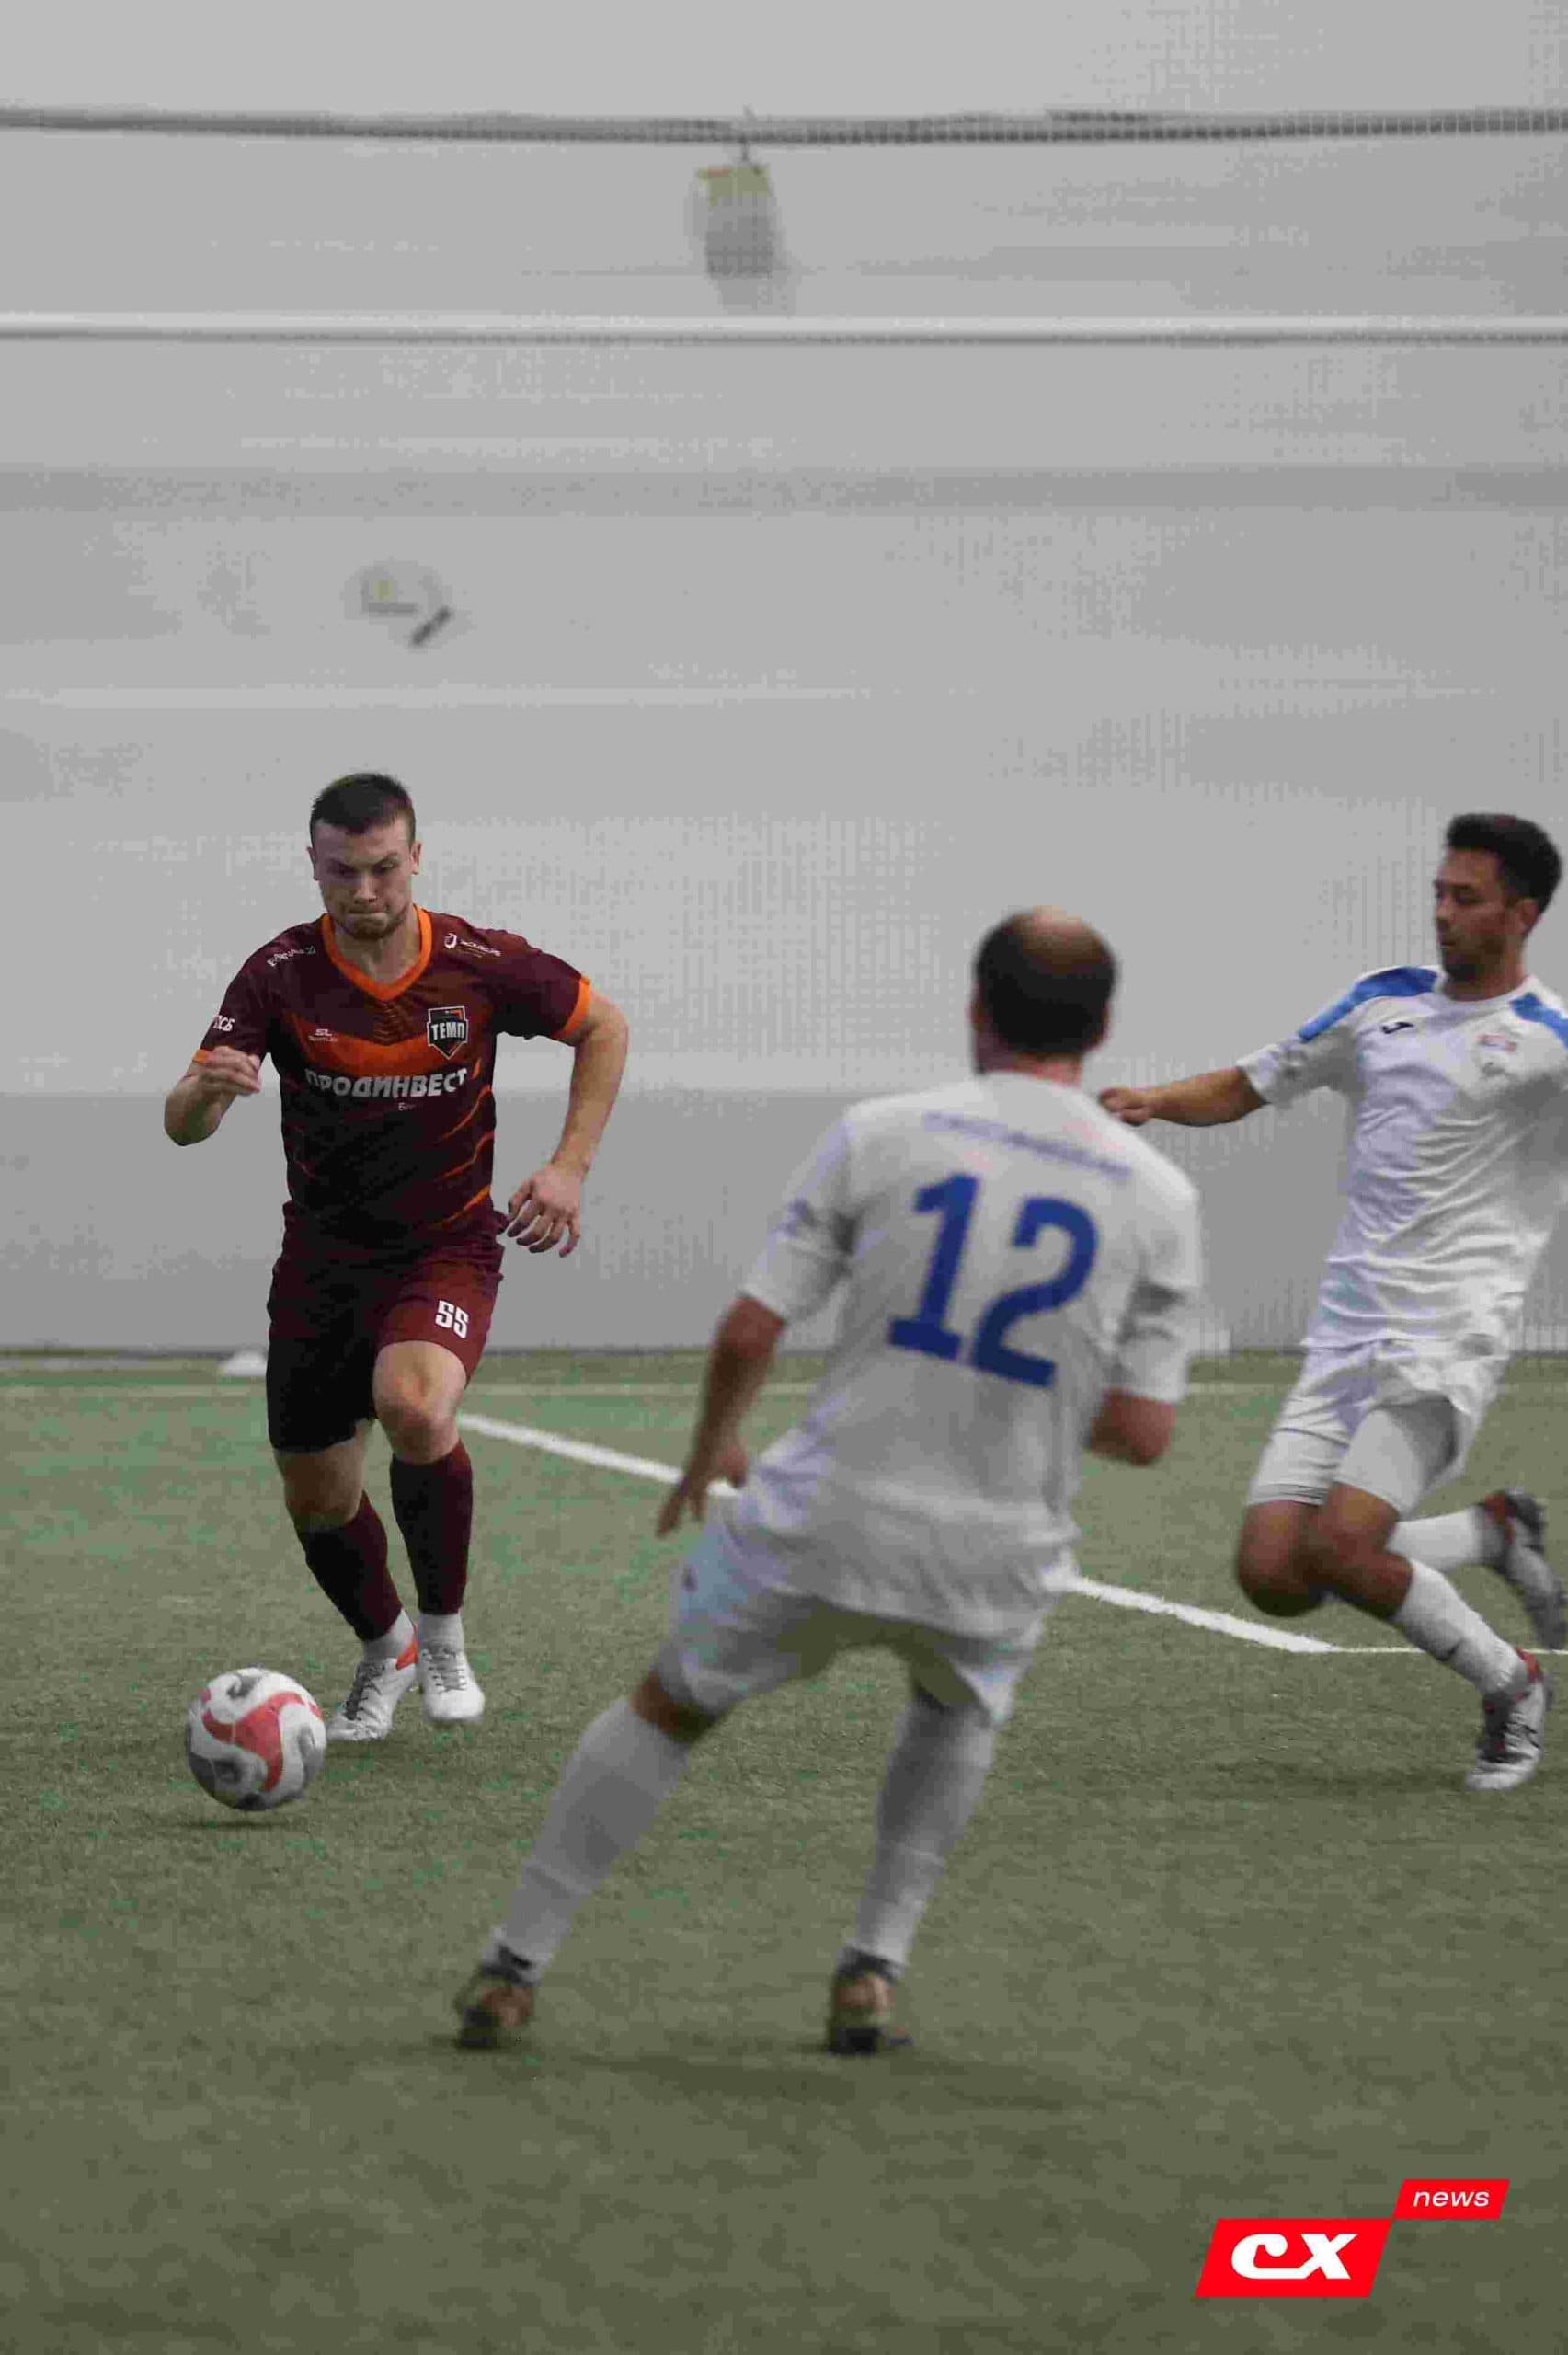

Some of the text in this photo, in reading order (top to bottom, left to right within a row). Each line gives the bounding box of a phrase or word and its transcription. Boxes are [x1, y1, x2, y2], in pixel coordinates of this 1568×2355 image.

[430, 1021, 465, 1040] ТЕМП
[304, 1067, 467, 1099] ПРОДИНВЕСТ
[887, 1172, 1099, 1387] 12
[435, 1299, 469, 1339] 55
